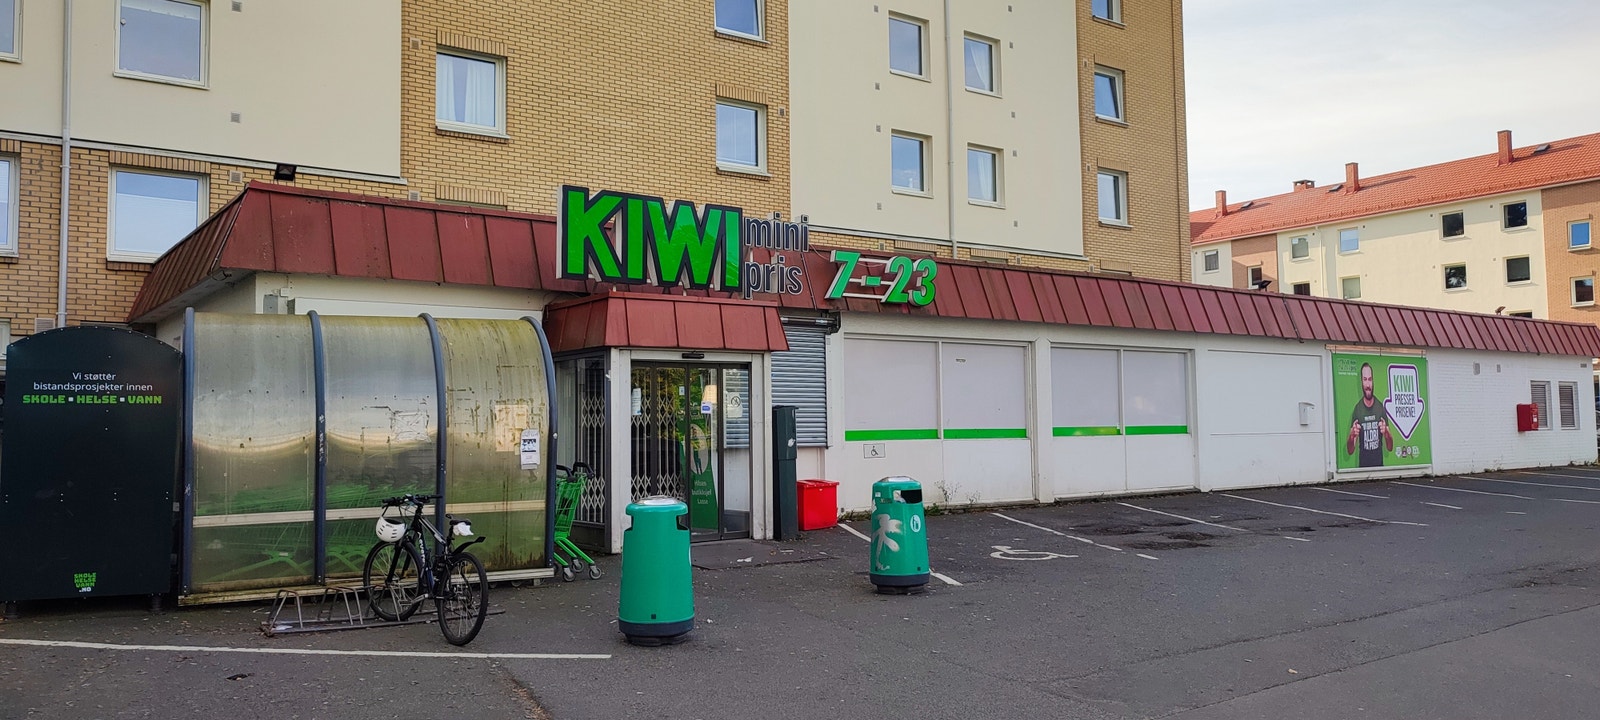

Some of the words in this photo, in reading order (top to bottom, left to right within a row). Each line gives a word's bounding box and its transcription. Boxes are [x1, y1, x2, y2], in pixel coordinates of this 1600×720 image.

[557, 184, 743, 293] KIWI
[744, 211, 809, 253] mini
[744, 254, 804, 300] pris
[72, 372, 82, 381] Vi
[84, 372, 116, 381] støtter
[33, 382, 124, 392] bistandsprosjekter
[126, 383, 153, 391] innen
[1393, 374, 1414, 392] KIWI
[22, 395, 66, 404] SKOLE
[76, 395, 118, 404] HELSE
[127, 395, 162, 404] VANN
[1394, 393, 1415, 405] PRESSER
